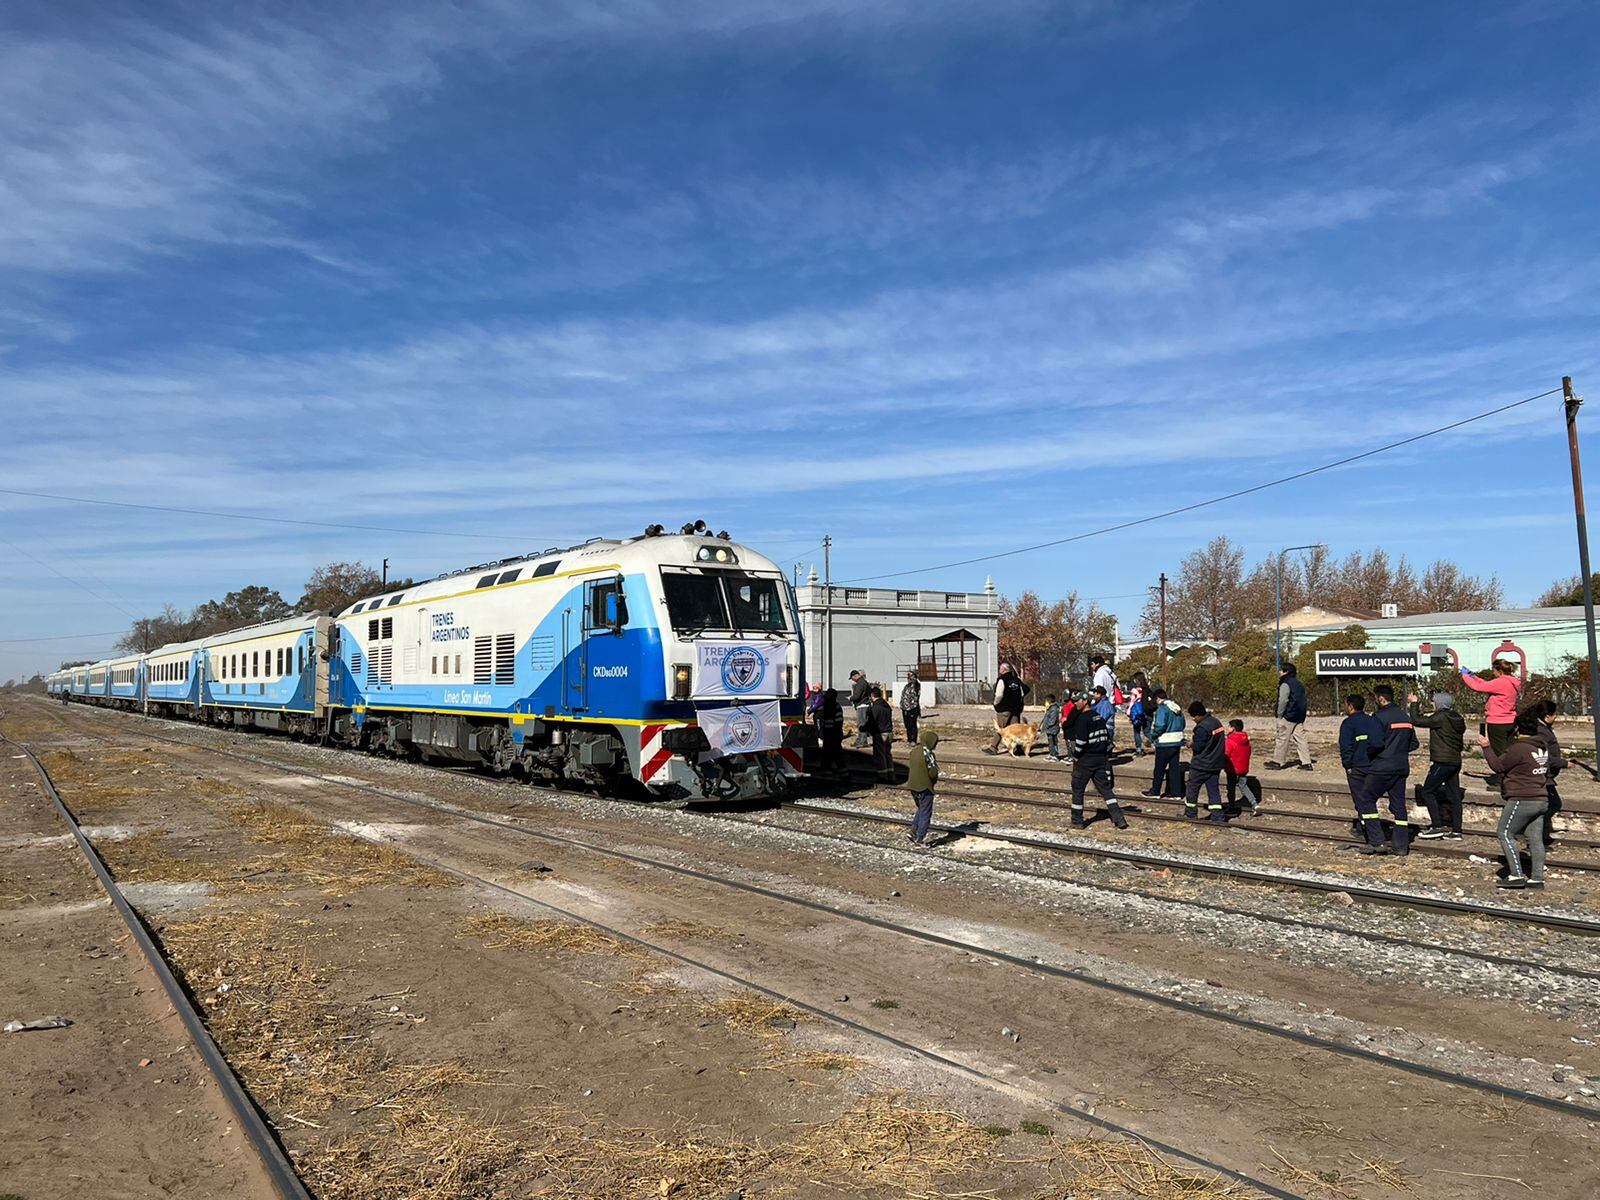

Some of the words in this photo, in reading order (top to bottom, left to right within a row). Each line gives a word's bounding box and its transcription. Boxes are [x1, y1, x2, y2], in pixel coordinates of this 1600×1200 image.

[432, 612, 454, 626] TRENES
[432, 627, 470, 642] ARGENTINOS
[1321, 657, 1356, 667] VICUÑA
[1359, 658, 1416, 667] MACKENNA
[460, 689, 472, 704] San
